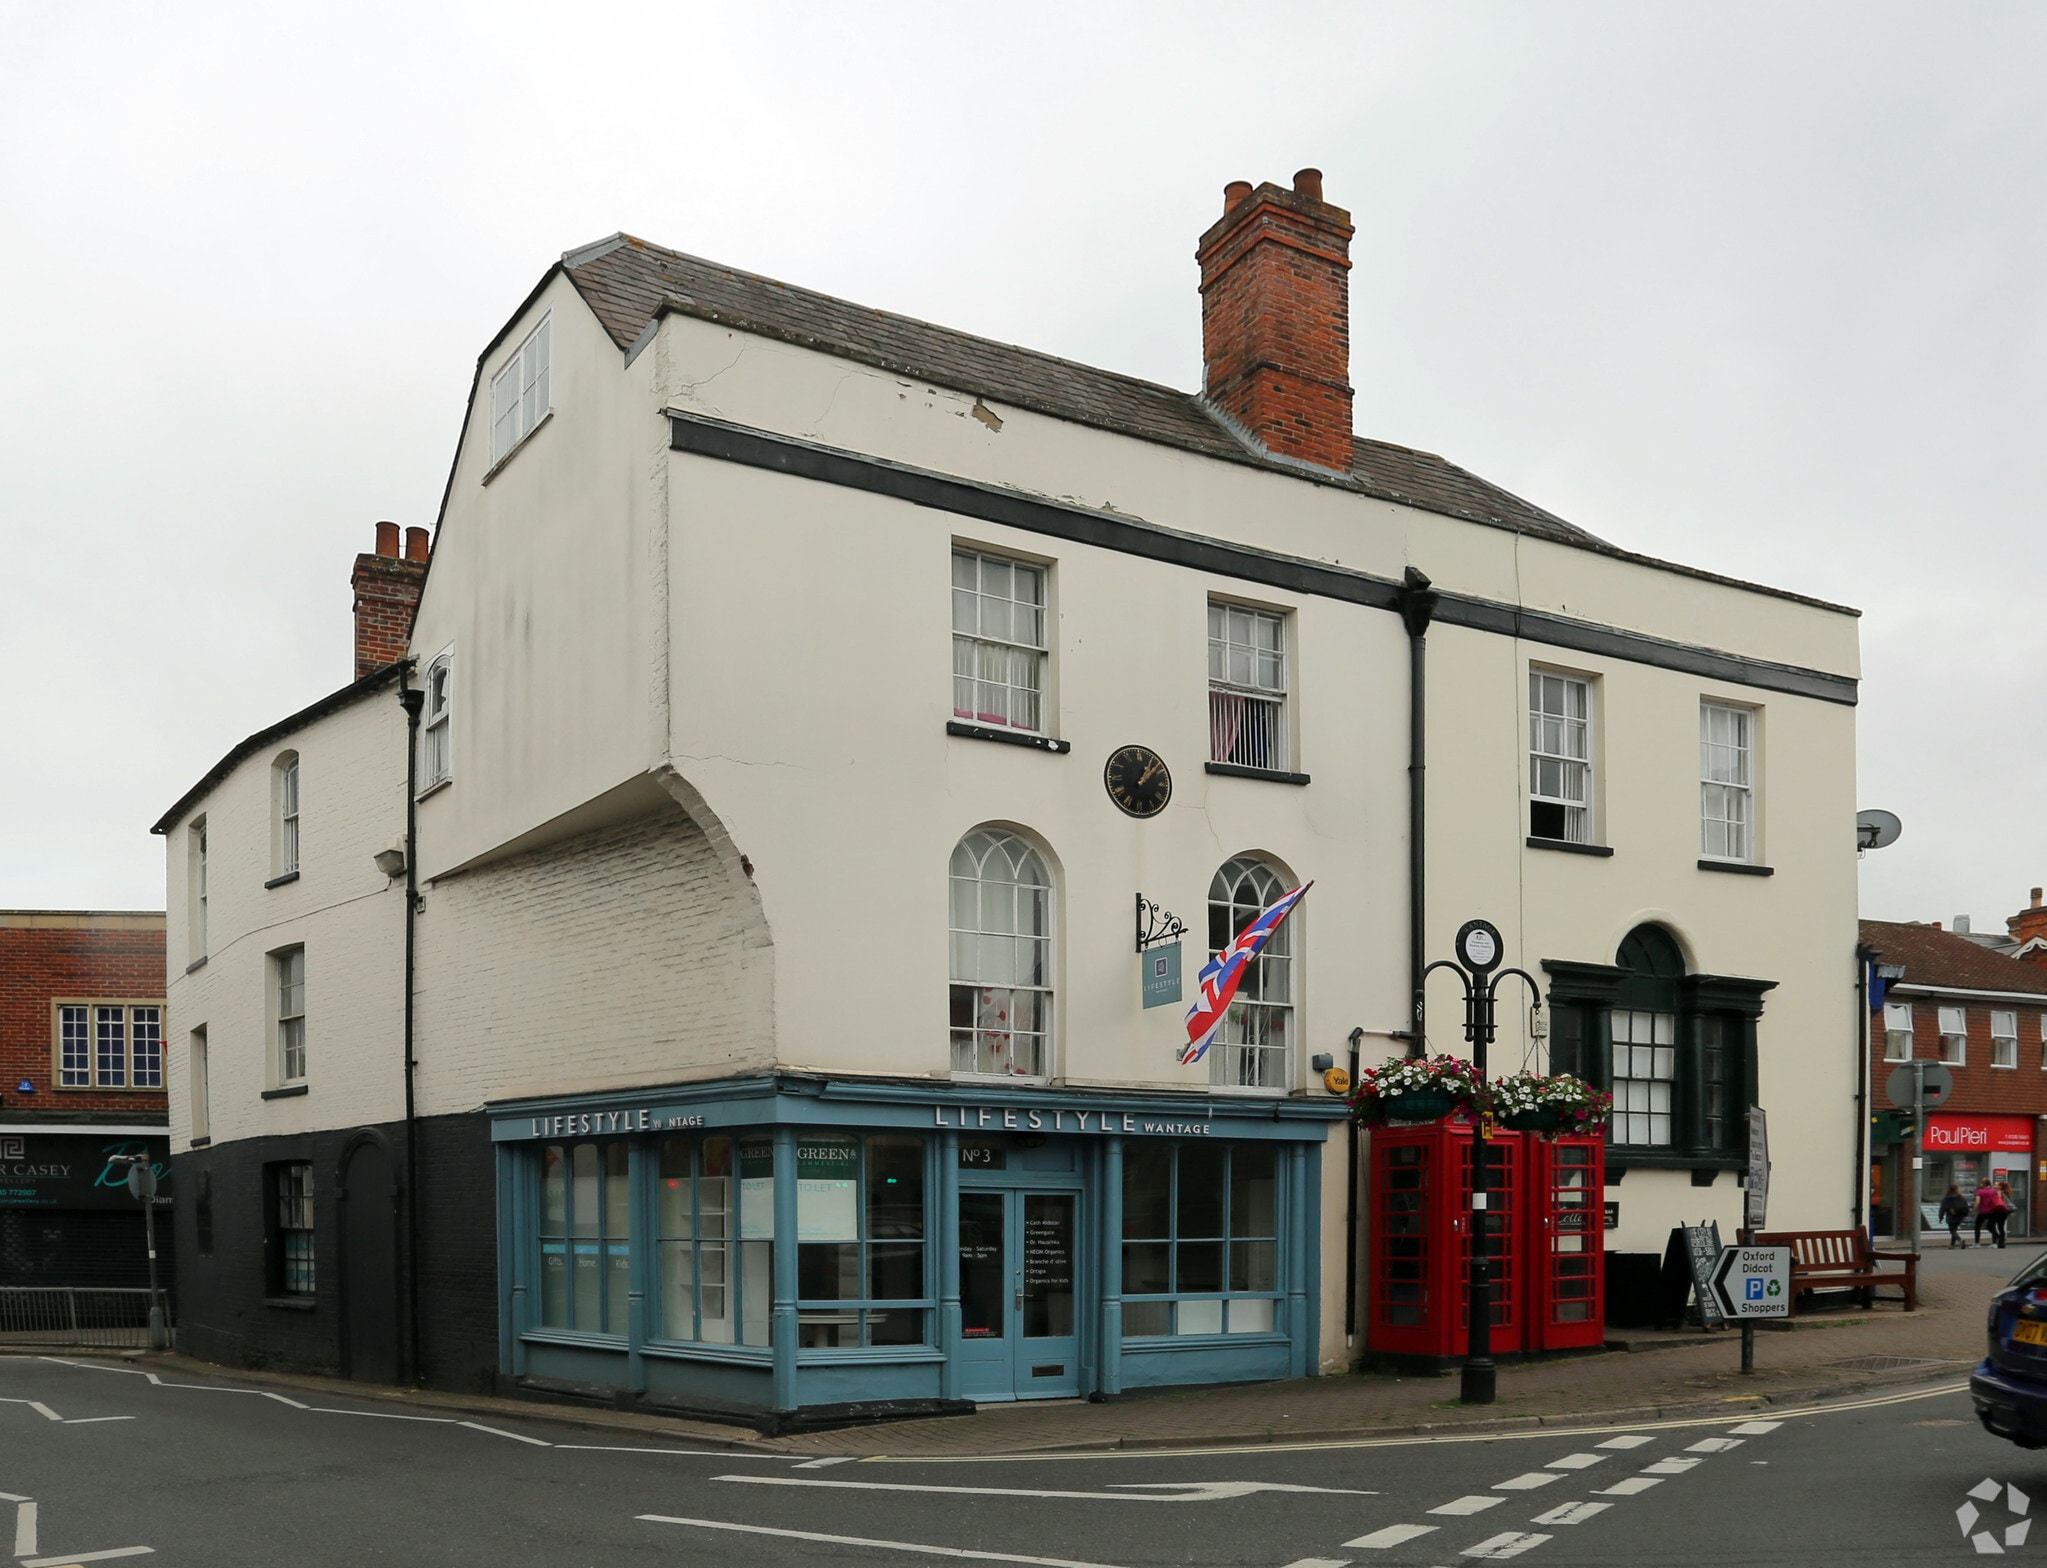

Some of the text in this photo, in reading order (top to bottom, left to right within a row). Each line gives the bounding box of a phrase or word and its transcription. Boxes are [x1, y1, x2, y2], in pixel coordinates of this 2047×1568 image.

[1144, 977, 1180, 992] LIFESTYLE
[1333, 1076, 1349, 1086] Yale
[532, 1109, 650, 1137] LIFESTYLE
[935, 1106, 1210, 1135] LIFESTYLE WANTAGE
[797, 1148, 849, 1160] GREEN
[983, 1149, 991, 1163] 3
[13, 1164, 71, 1176] CASEY
[742, 1182, 765, 1191] TO LET
[814, 1184, 832, 1192] LET
[1742, 1251, 1775, 1261] Oxford
[1742, 1263, 1773, 1273] Didcot
[1749, 1280, 1762, 1299] P
[1741, 1303, 1786, 1315] Shoppers
